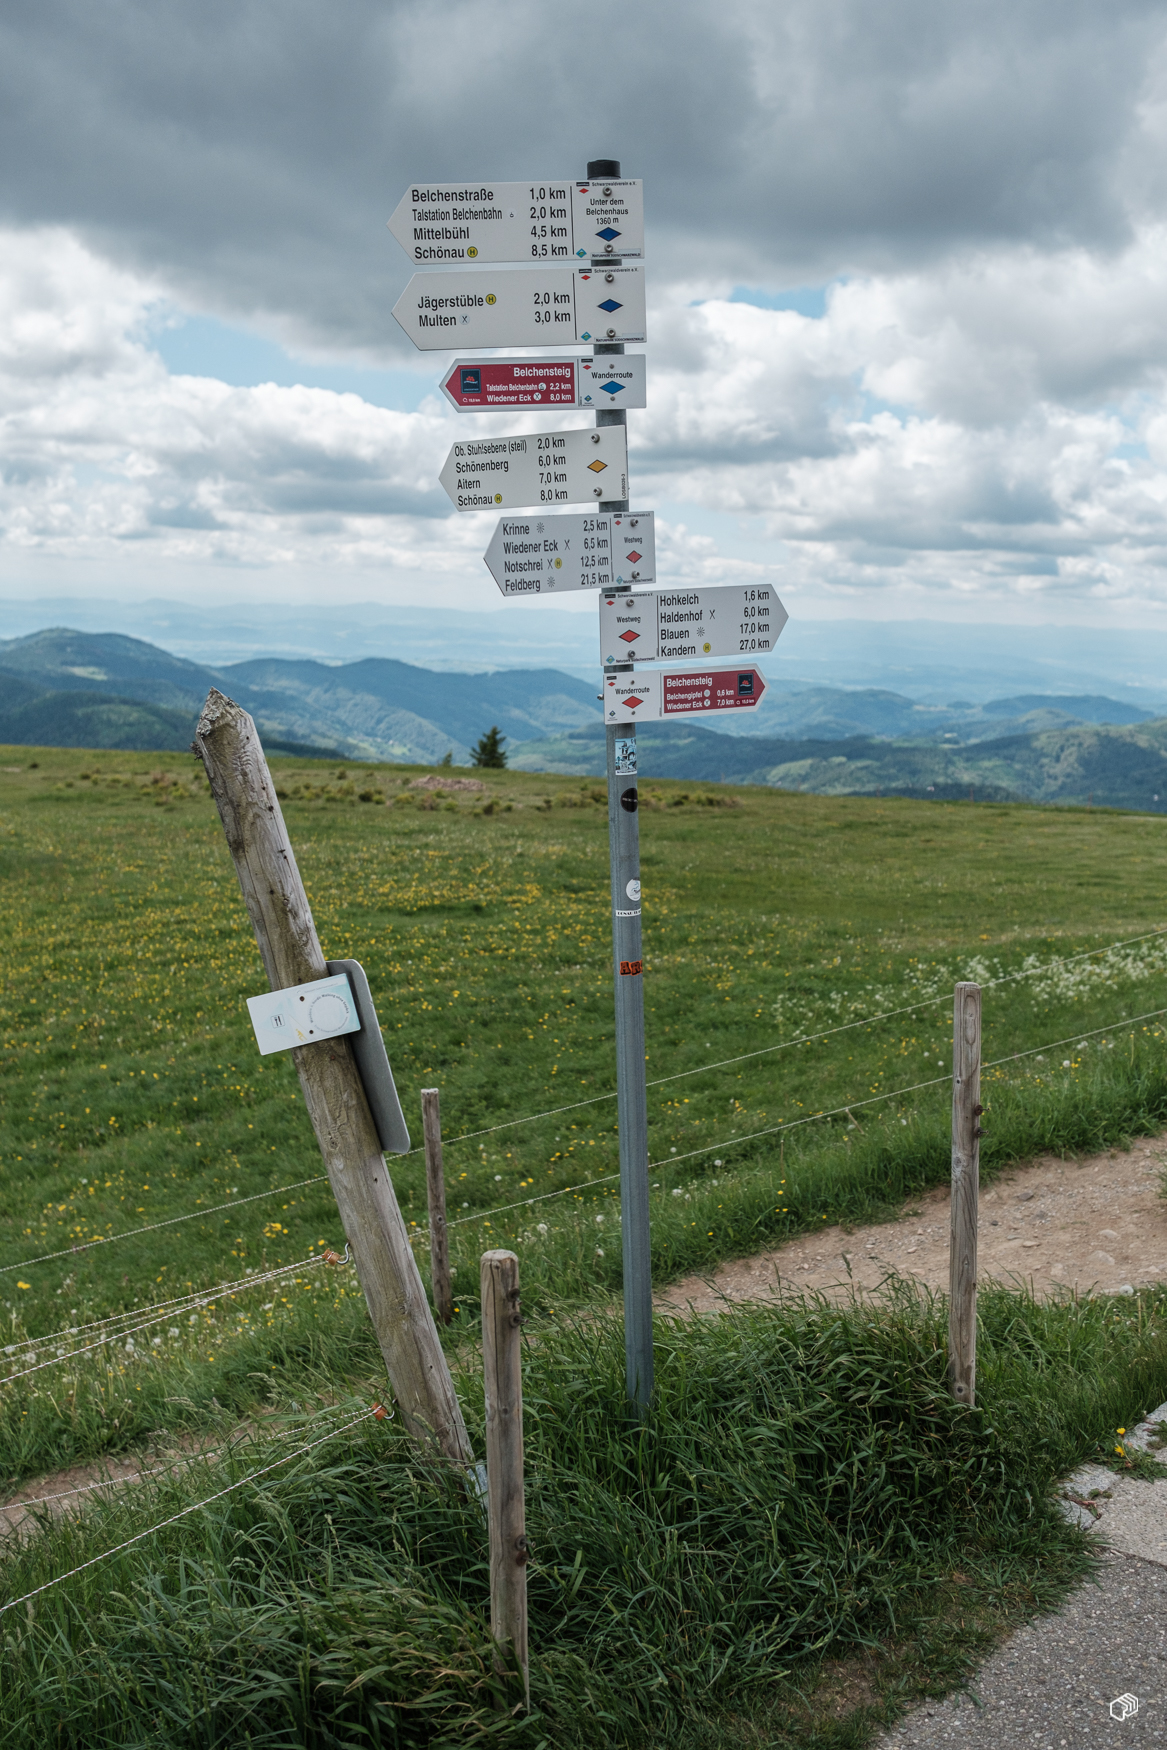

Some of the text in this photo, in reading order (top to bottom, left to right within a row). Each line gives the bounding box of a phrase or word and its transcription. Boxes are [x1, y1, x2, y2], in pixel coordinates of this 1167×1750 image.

[411, 187, 566, 202] Belchenstraße 1,0 km
[590, 198, 608, 206] Unter
[412, 206, 566, 221] Talstation Belchenbahn 2,0 km
[586, 208, 628, 216] Belchenhaus
[414, 225, 567, 240] Mittelbühl 4,5 km
[414, 246, 464, 259] Schönau
[532, 244, 548, 258] 8,5
[552, 244, 568, 256] km
[418, 294, 484, 312] Jägerstüble
[534, 292, 550, 306] 2,0
[554, 292, 570, 304] km
[419, 310, 571, 327] Multen 3,0 km
[513, 366, 570, 378] Belchensteig
[486, 384, 508, 392] Talstation
[550, 383, 560, 391] 2,2
[561, 382, 571, 390] km
[486, 394, 517, 402] Wiedener
[518, 394, 532, 402] Eck
[550, 394, 560, 402] 8,0
[454, 436, 566, 457] Ob. Stuhlsebene (steil) 2,0 km
[456, 454, 566, 473] Schönenberg 6,0 km
[457, 472, 567, 490] Aitern 7,0 km
[458, 494, 492, 506] Schönau
[540, 490, 552, 502] 8,0
[555, 489, 568, 500] km
[502, 519, 608, 536] Krinne 2,5 km
[503, 537, 608, 554] Wiedener Eck 6,5 km
[504, 559, 543, 573] Notschrei
[581, 556, 595, 569] 12,5
[598, 555, 608, 566] km
[505, 573, 609, 592] Feldberg 21,5 km
[660, 590, 769, 607] Hohkelch 1,6 km
[660, 606, 769, 623] Haldenhof 6,0 km
[661, 622, 769, 640] Blauen 17,0 km
[661, 645, 696, 657] Kandern
[740, 639, 756, 652] 27,0
[758, 638, 769, 649] km
[667, 676, 712, 687] Belchensteig
[667, 692, 702, 700] Belchengipfel
